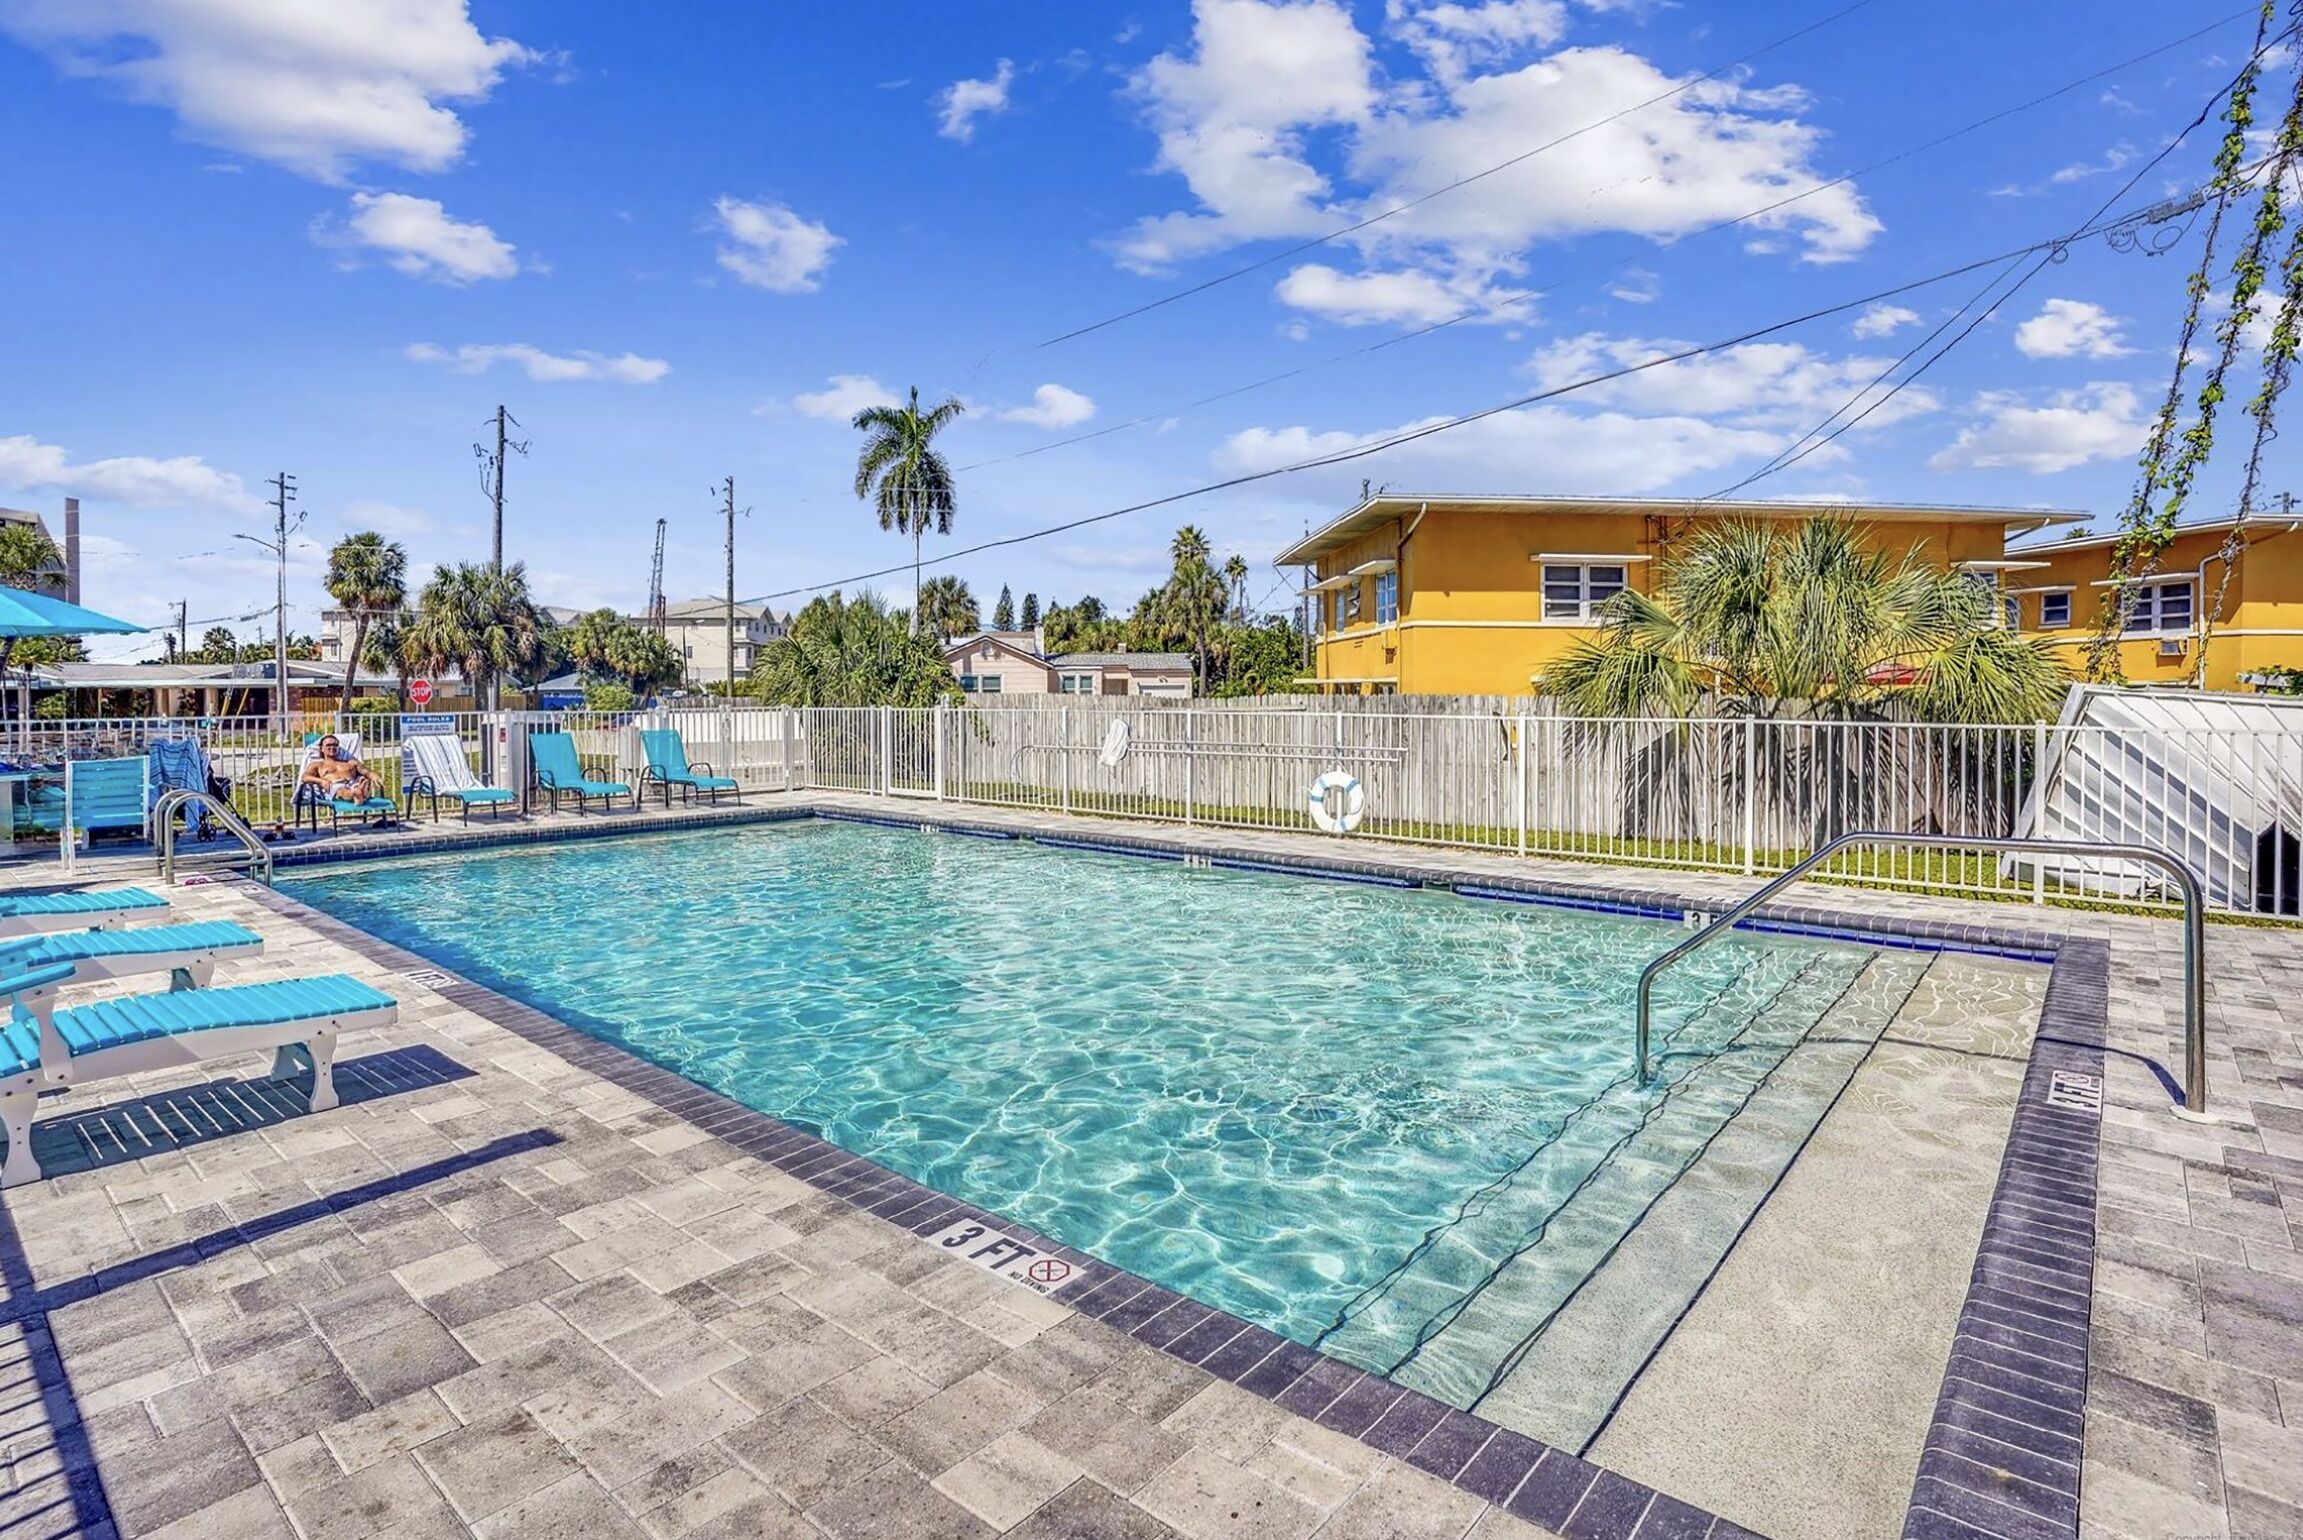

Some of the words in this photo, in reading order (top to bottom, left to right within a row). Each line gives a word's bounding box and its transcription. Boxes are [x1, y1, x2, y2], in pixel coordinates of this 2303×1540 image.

[412, 686, 431, 697] STOP
[2053, 1082, 2099, 1100] FT
[942, 1226, 985, 1247] 3
[968, 1238, 1037, 1270] FT
[1008, 1271, 1023, 1280] NO
[1020, 1277, 1050, 1293] DIVING
